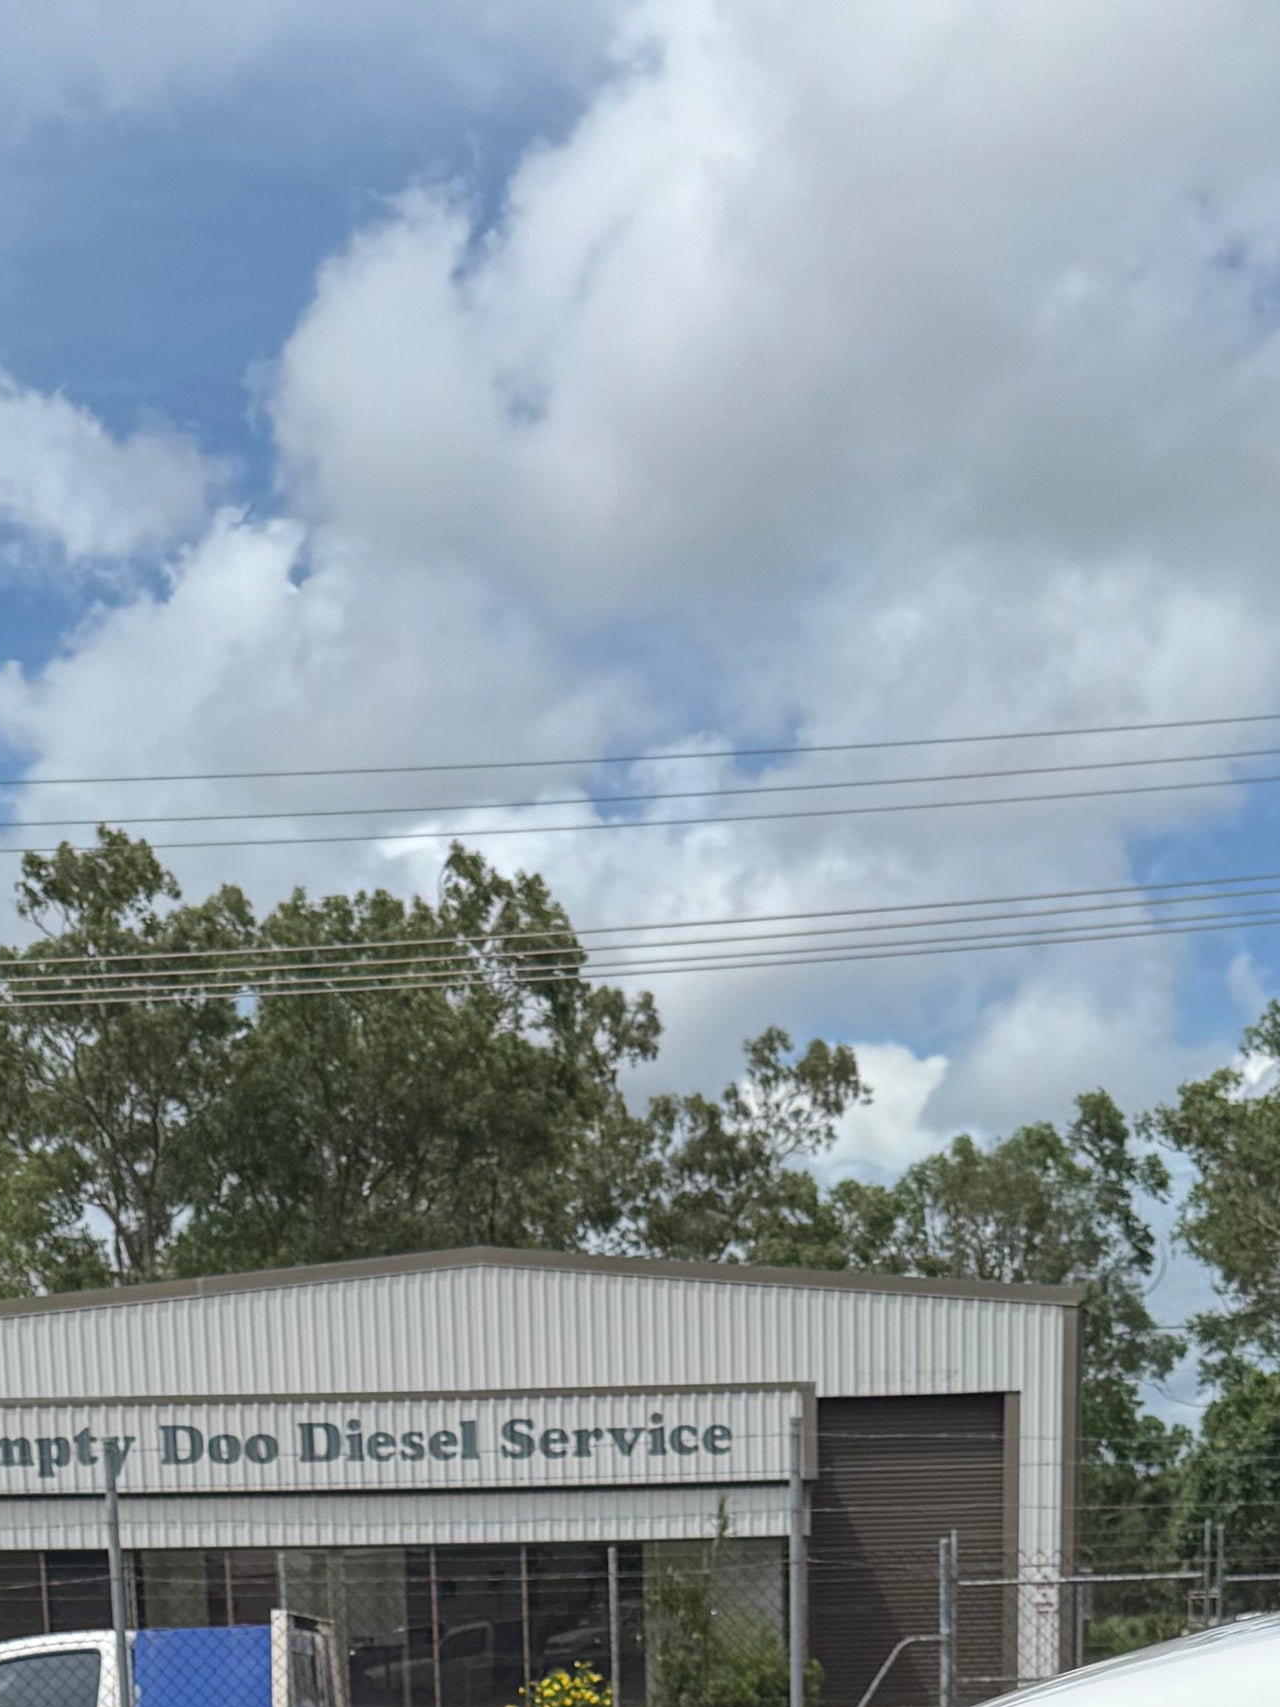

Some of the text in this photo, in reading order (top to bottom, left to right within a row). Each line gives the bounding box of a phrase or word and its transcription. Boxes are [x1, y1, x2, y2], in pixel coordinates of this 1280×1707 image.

[158, 1425, 280, 1466] Doo
[297, 1418, 481, 1463] Diesel
[500, 1411, 734, 1461] Service
